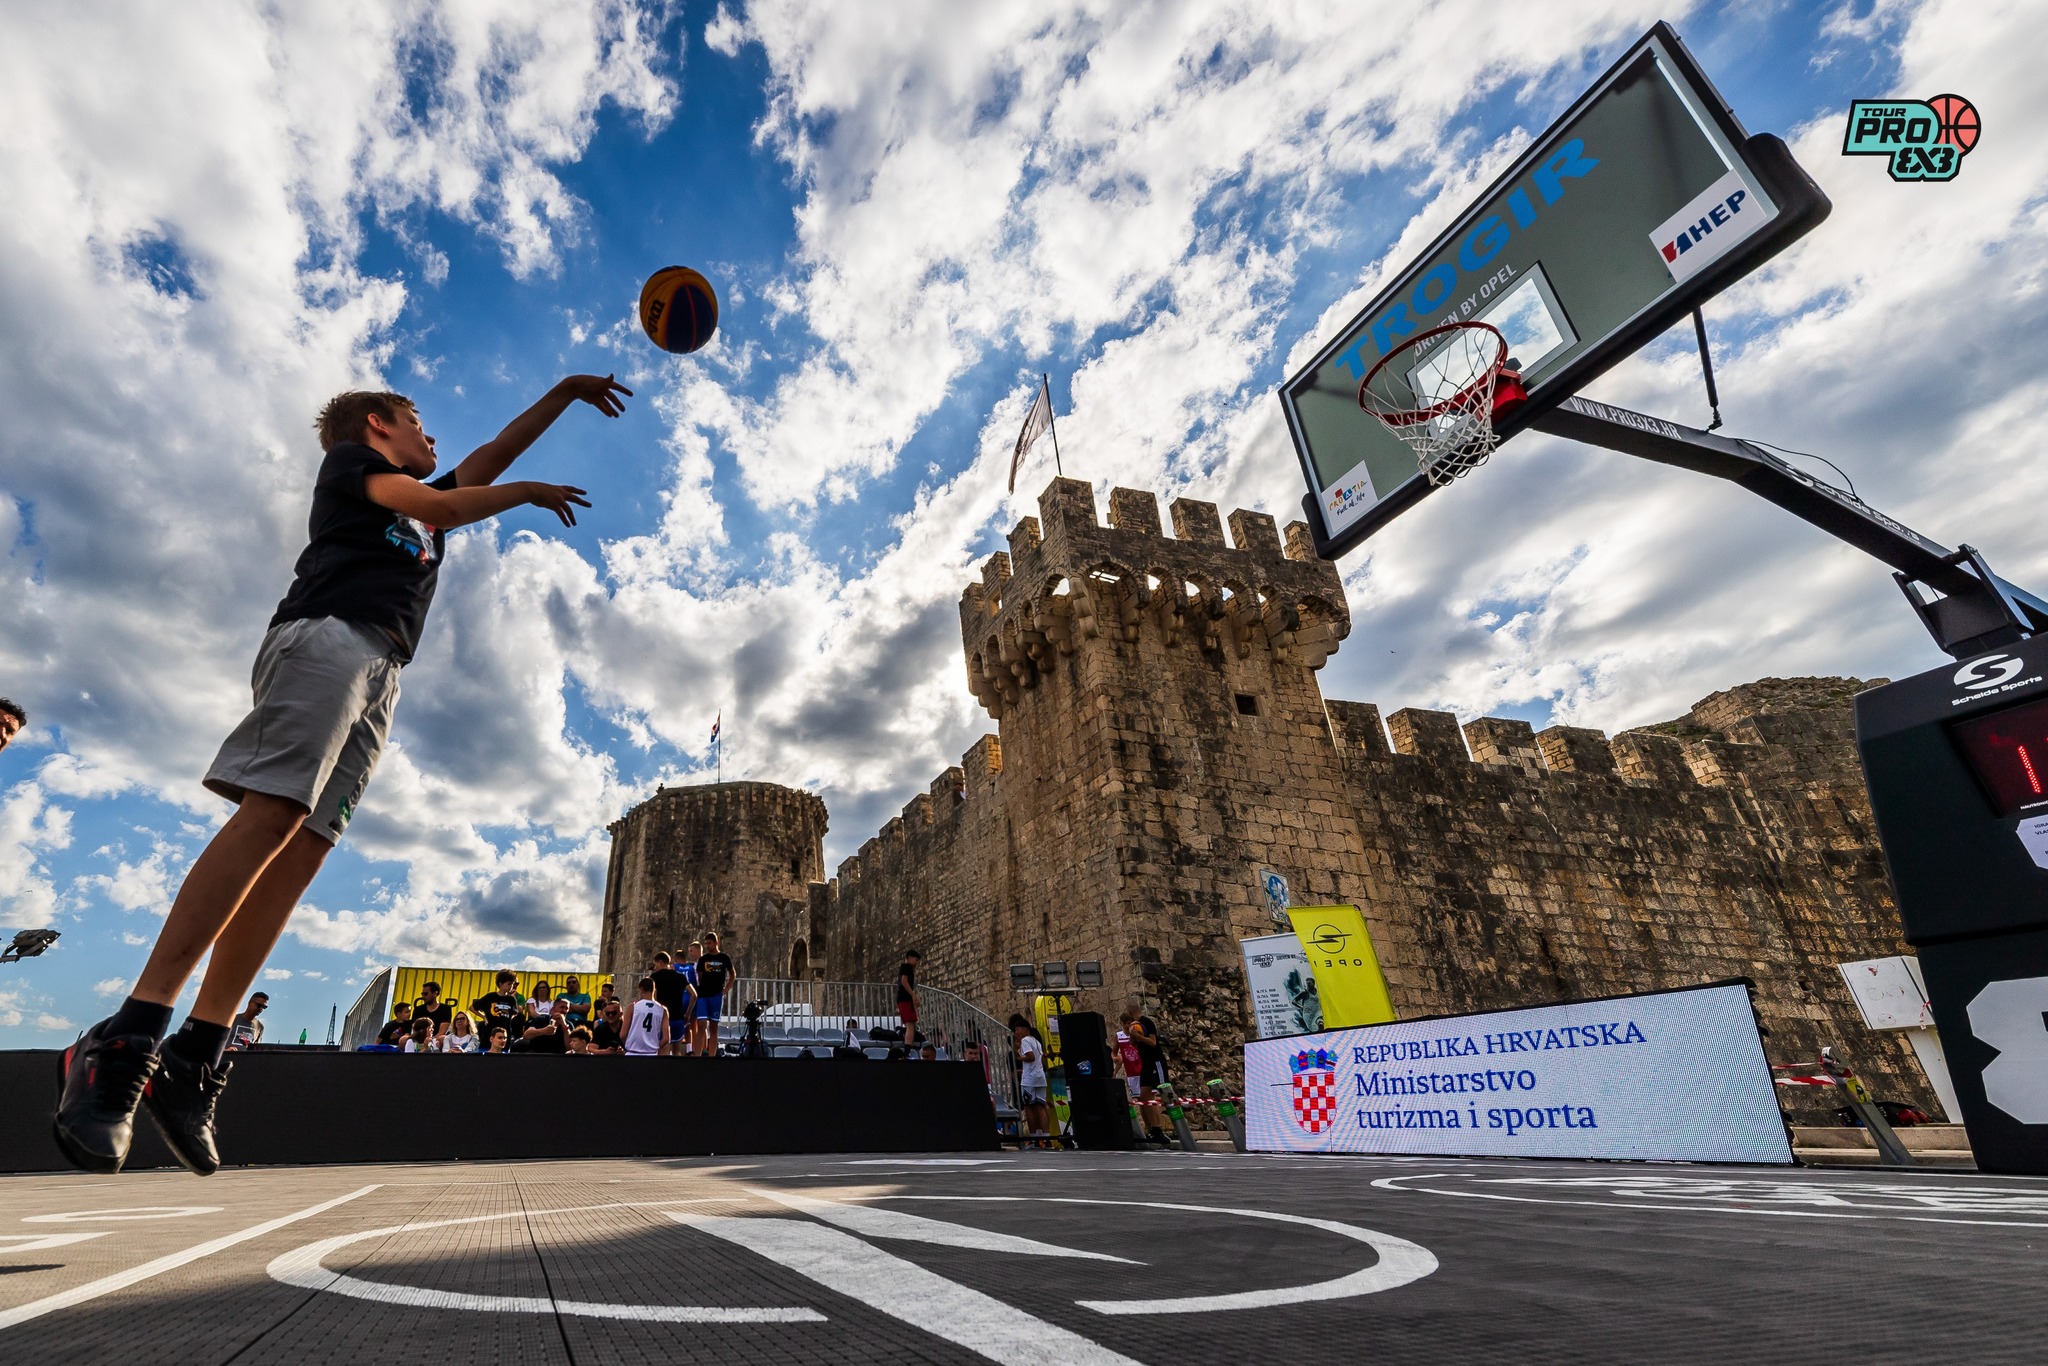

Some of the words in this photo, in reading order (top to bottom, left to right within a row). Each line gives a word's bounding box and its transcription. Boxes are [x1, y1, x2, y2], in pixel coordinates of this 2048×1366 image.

[1334, 137, 1600, 381] TROGIR
[1460, 293, 1478, 316] BY
[1479, 264, 1517, 299] OPEL
[1569, 396, 1682, 440] WWW.PRO3X3.HR
[1951, 688, 1999, 706] Schelde
[2001, 676, 2043, 692] Sports
[2017, 745, 2042, 794] 1
[642, 1012, 654, 1033] 4
[1353, 1036, 1480, 1064] REPUBLIKA
[1484, 1021, 1647, 1055] HRVATSKA
[1355, 1068, 1536, 1097] Ministarstvo
[1357, 1103, 1462, 1129] turizma
[1467, 1101, 1480, 1128] i
[1487, 1103, 1598, 1135] sporta
